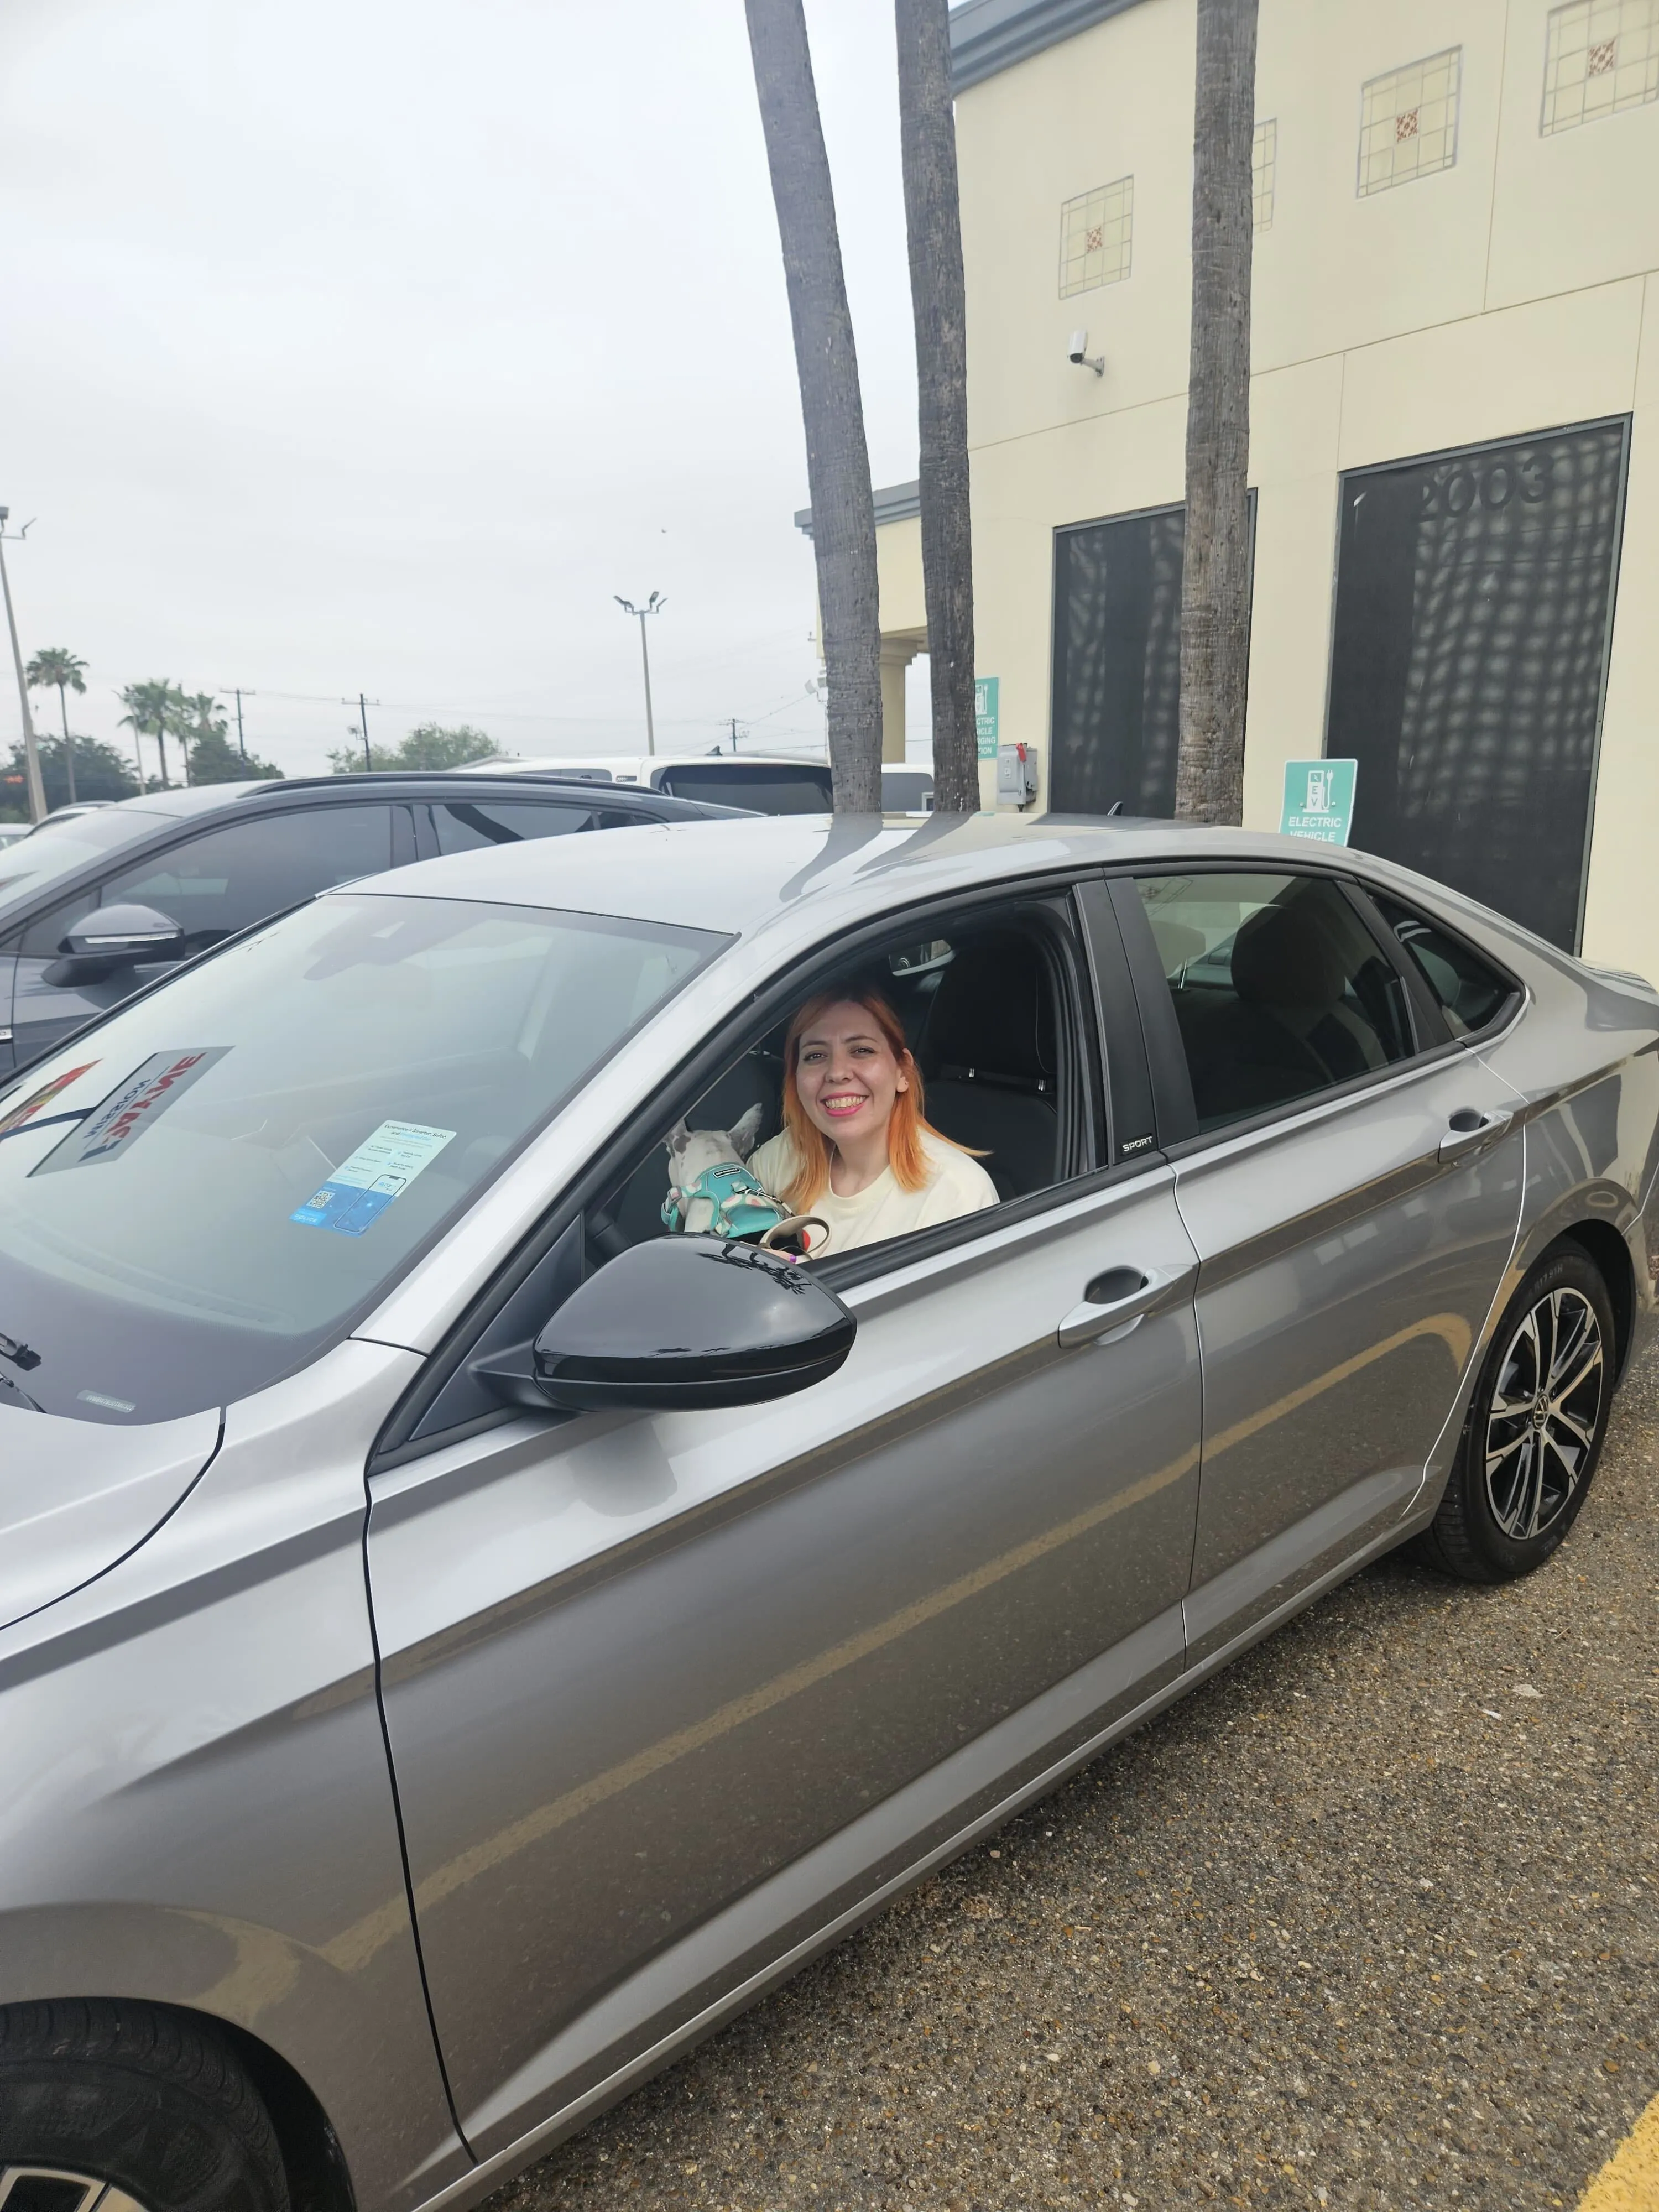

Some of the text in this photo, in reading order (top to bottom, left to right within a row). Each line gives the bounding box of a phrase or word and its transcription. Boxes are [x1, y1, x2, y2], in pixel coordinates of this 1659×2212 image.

[977, 717, 995, 725] CTRIC
[977, 736, 996, 744] RGING
[1288, 816, 1342, 828] ELECTRIC
[1123, 1136, 1152, 1152] SPORT
